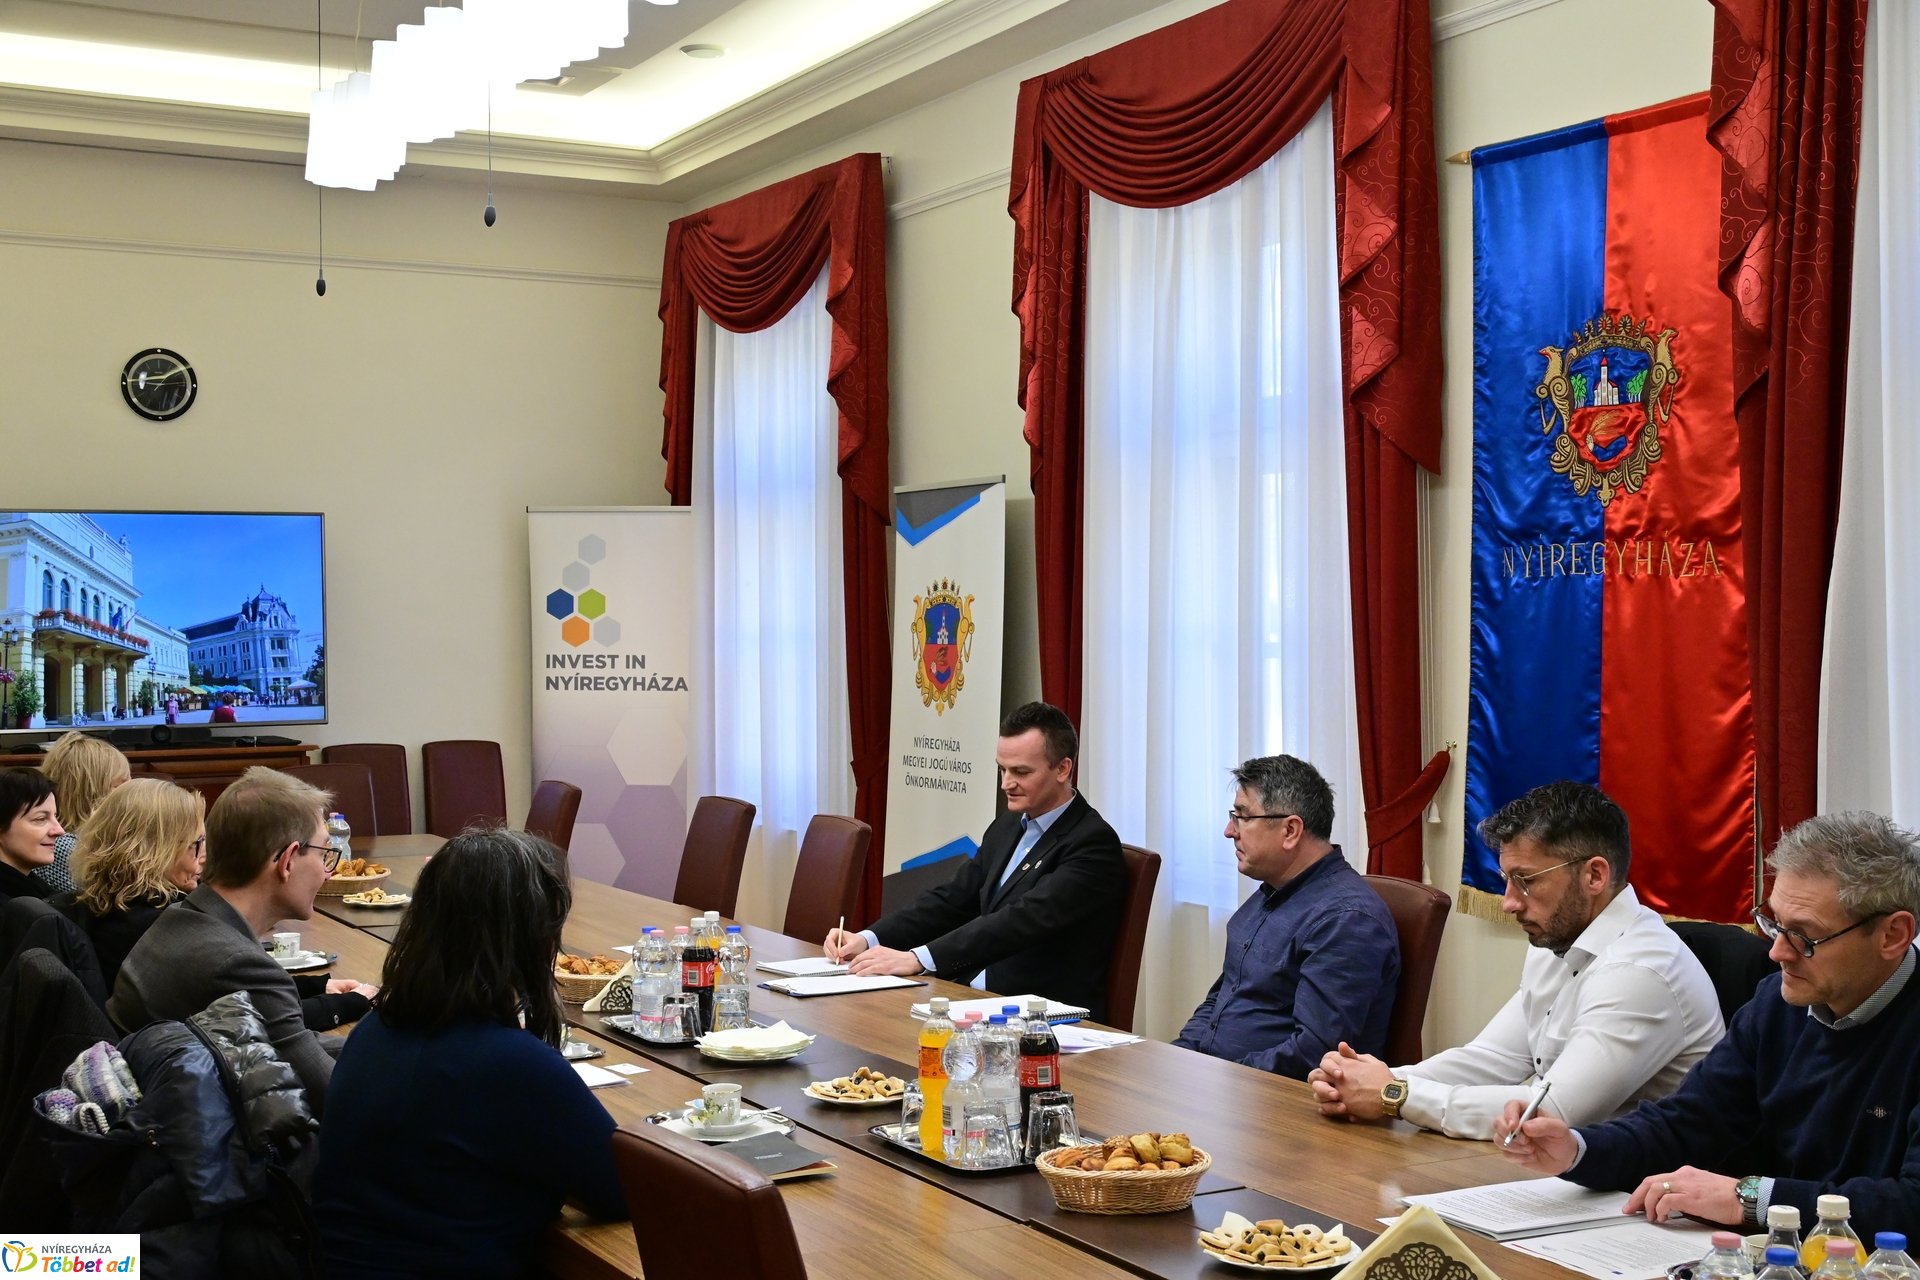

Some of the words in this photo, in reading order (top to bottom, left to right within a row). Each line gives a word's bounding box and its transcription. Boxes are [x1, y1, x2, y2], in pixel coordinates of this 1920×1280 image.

[1503, 532, 1721, 578] NYÍREGYHÁZA
[545, 654, 619, 669] INVEST
[625, 654, 646, 669] IN
[545, 672, 689, 692] NYÍREGYHÁZA
[913, 734, 961, 752] NYÍREGYHÁZA
[902, 754, 927, 769] MEGYEI
[928, 756, 947, 771] JOGÚ
[949, 757, 972, 774] VÁROS
[904, 772, 967, 794] ÖNKORMÁNYZATA
